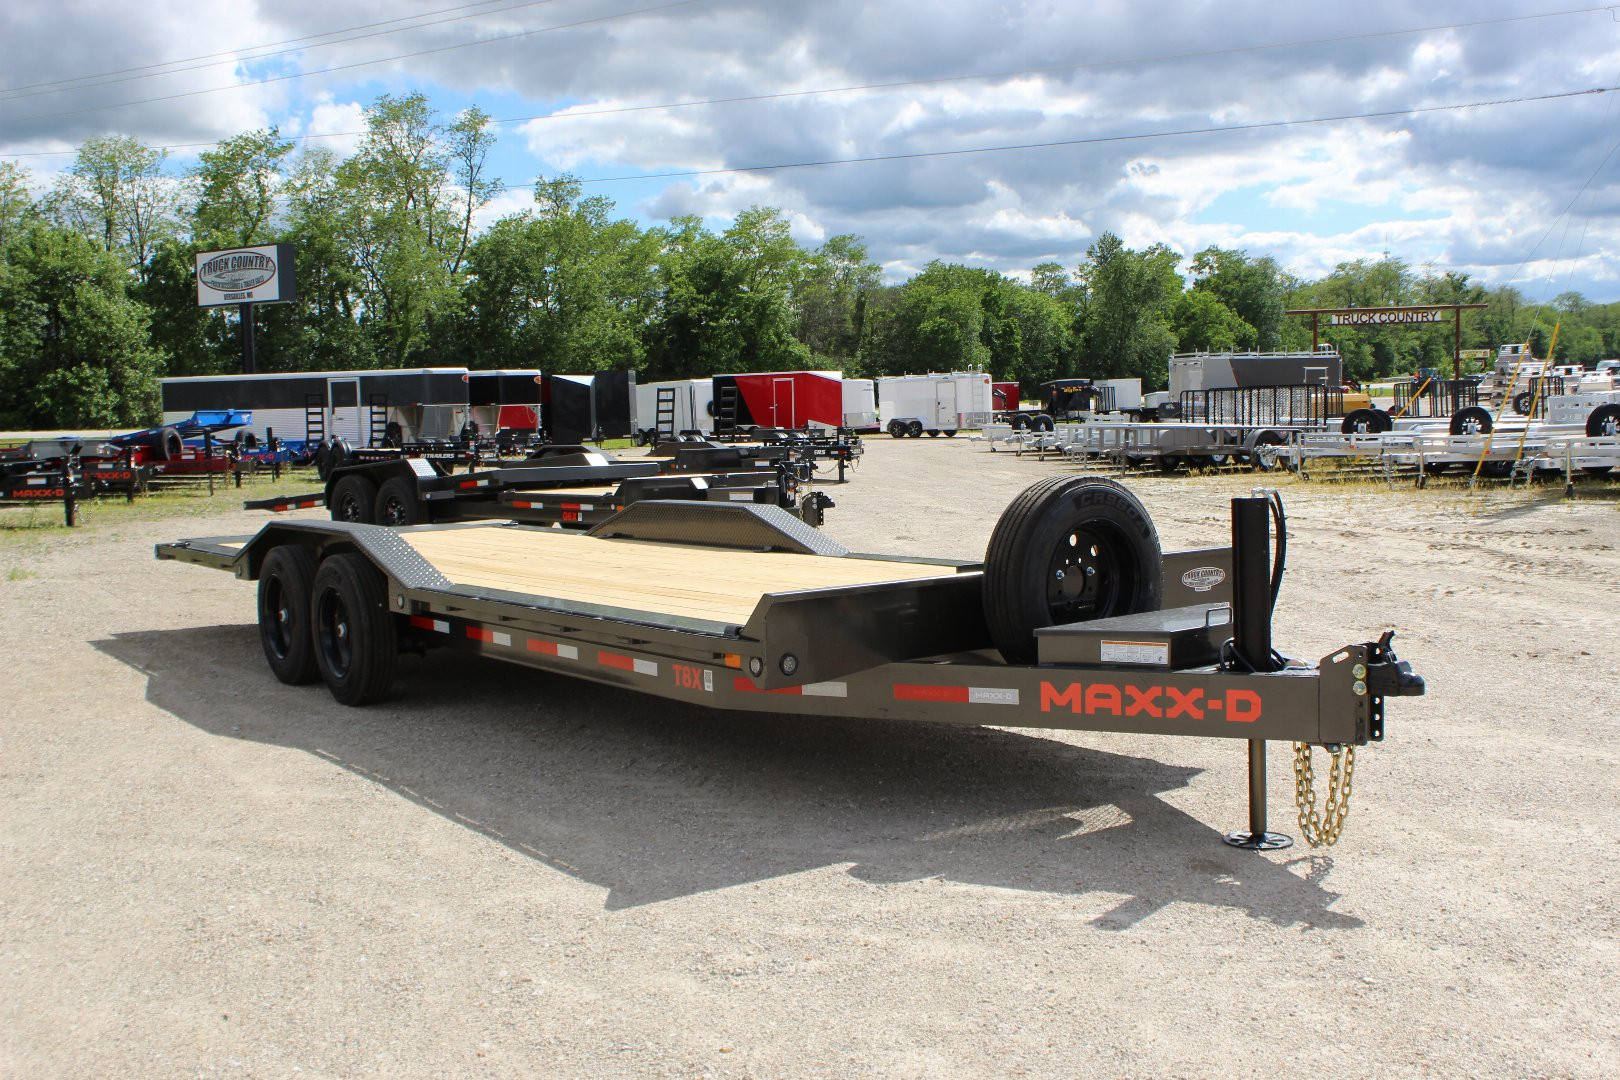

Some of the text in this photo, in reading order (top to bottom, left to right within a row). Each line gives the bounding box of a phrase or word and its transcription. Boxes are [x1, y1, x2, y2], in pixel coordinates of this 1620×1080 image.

[203, 256, 270, 275] TRUCK COUNTRY
[1334, 310, 1439, 325] TRUCK COUNTRY
[12, 488, 65, 498] MAXX-D
[671, 663, 703, 691] T8X
[975, 691, 1012, 700] MAXX-D
[1040, 681, 1262, 723] MAXX-D
